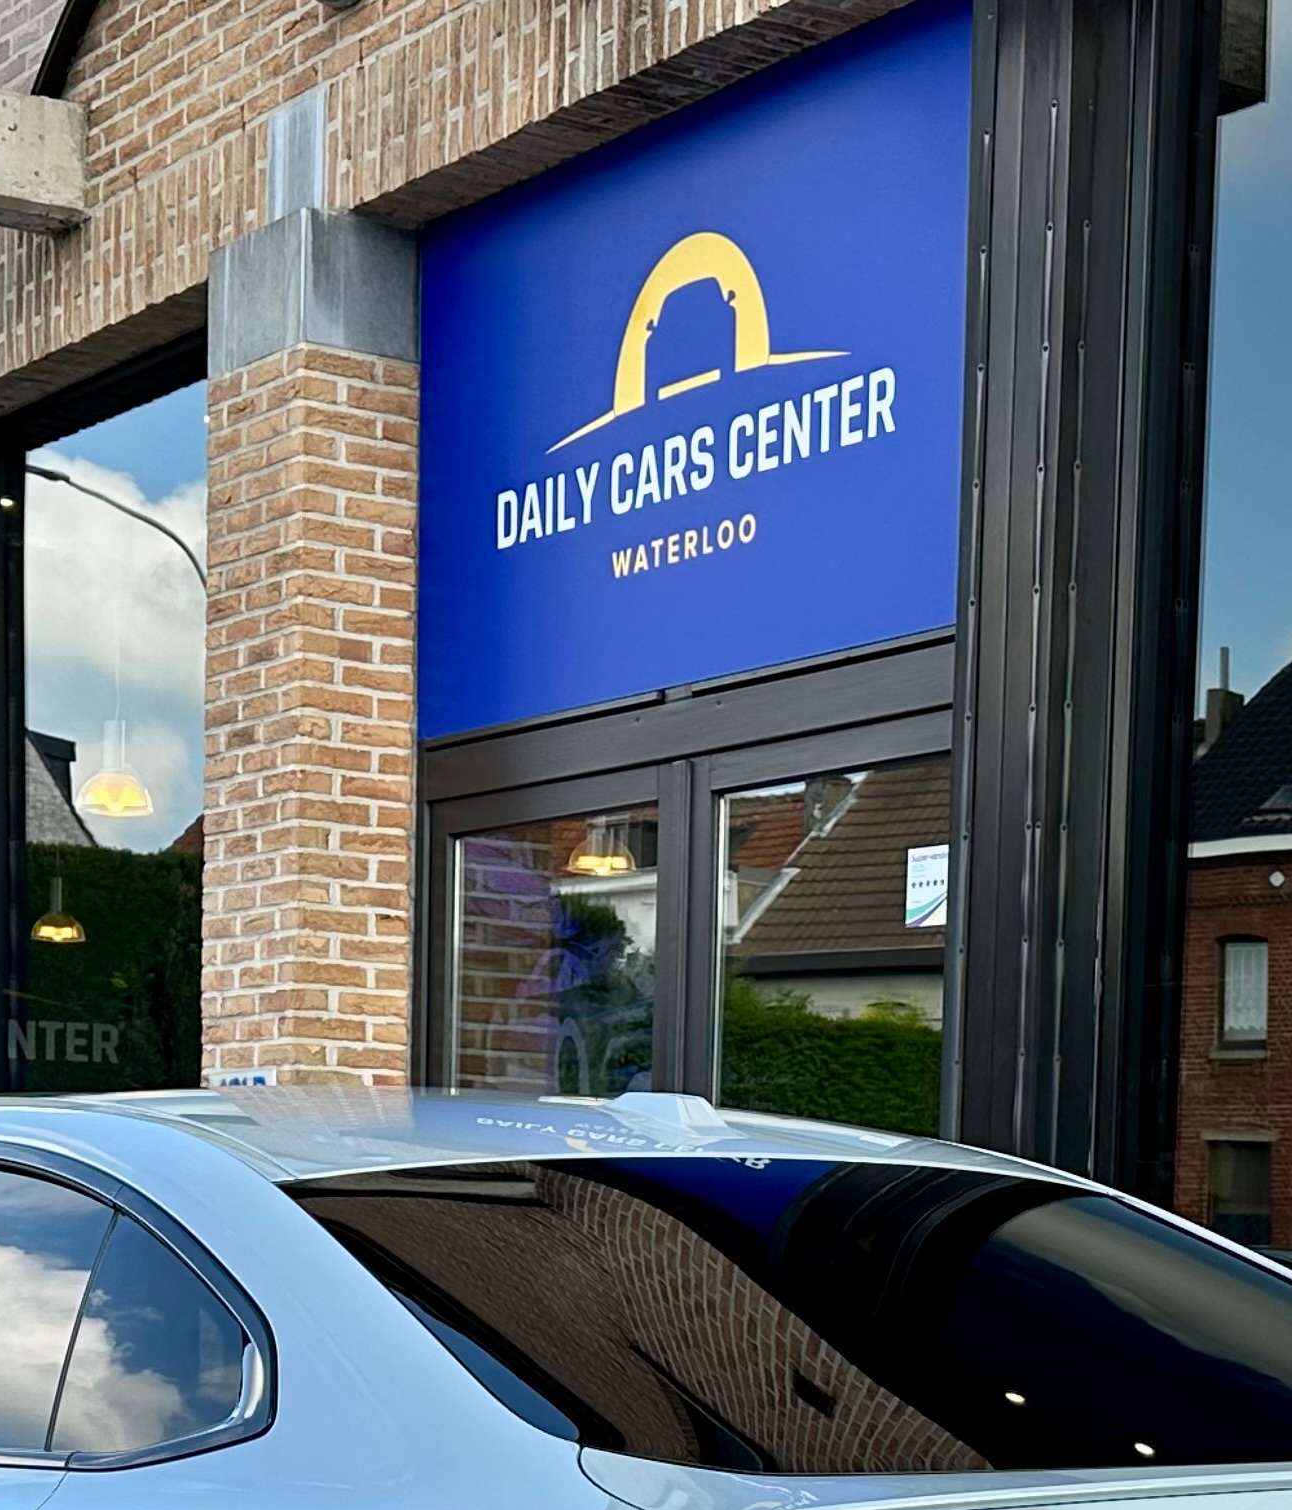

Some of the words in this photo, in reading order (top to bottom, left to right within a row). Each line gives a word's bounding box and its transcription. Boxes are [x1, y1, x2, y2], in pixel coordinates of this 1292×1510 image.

[497, 461, 601, 550] DAILY
[610, 425, 716, 516] CARS
[728, 366, 898, 481] CENTER
[612, 513, 757, 579] WATERLOO
[8, 1018, 119, 1064] NTER
